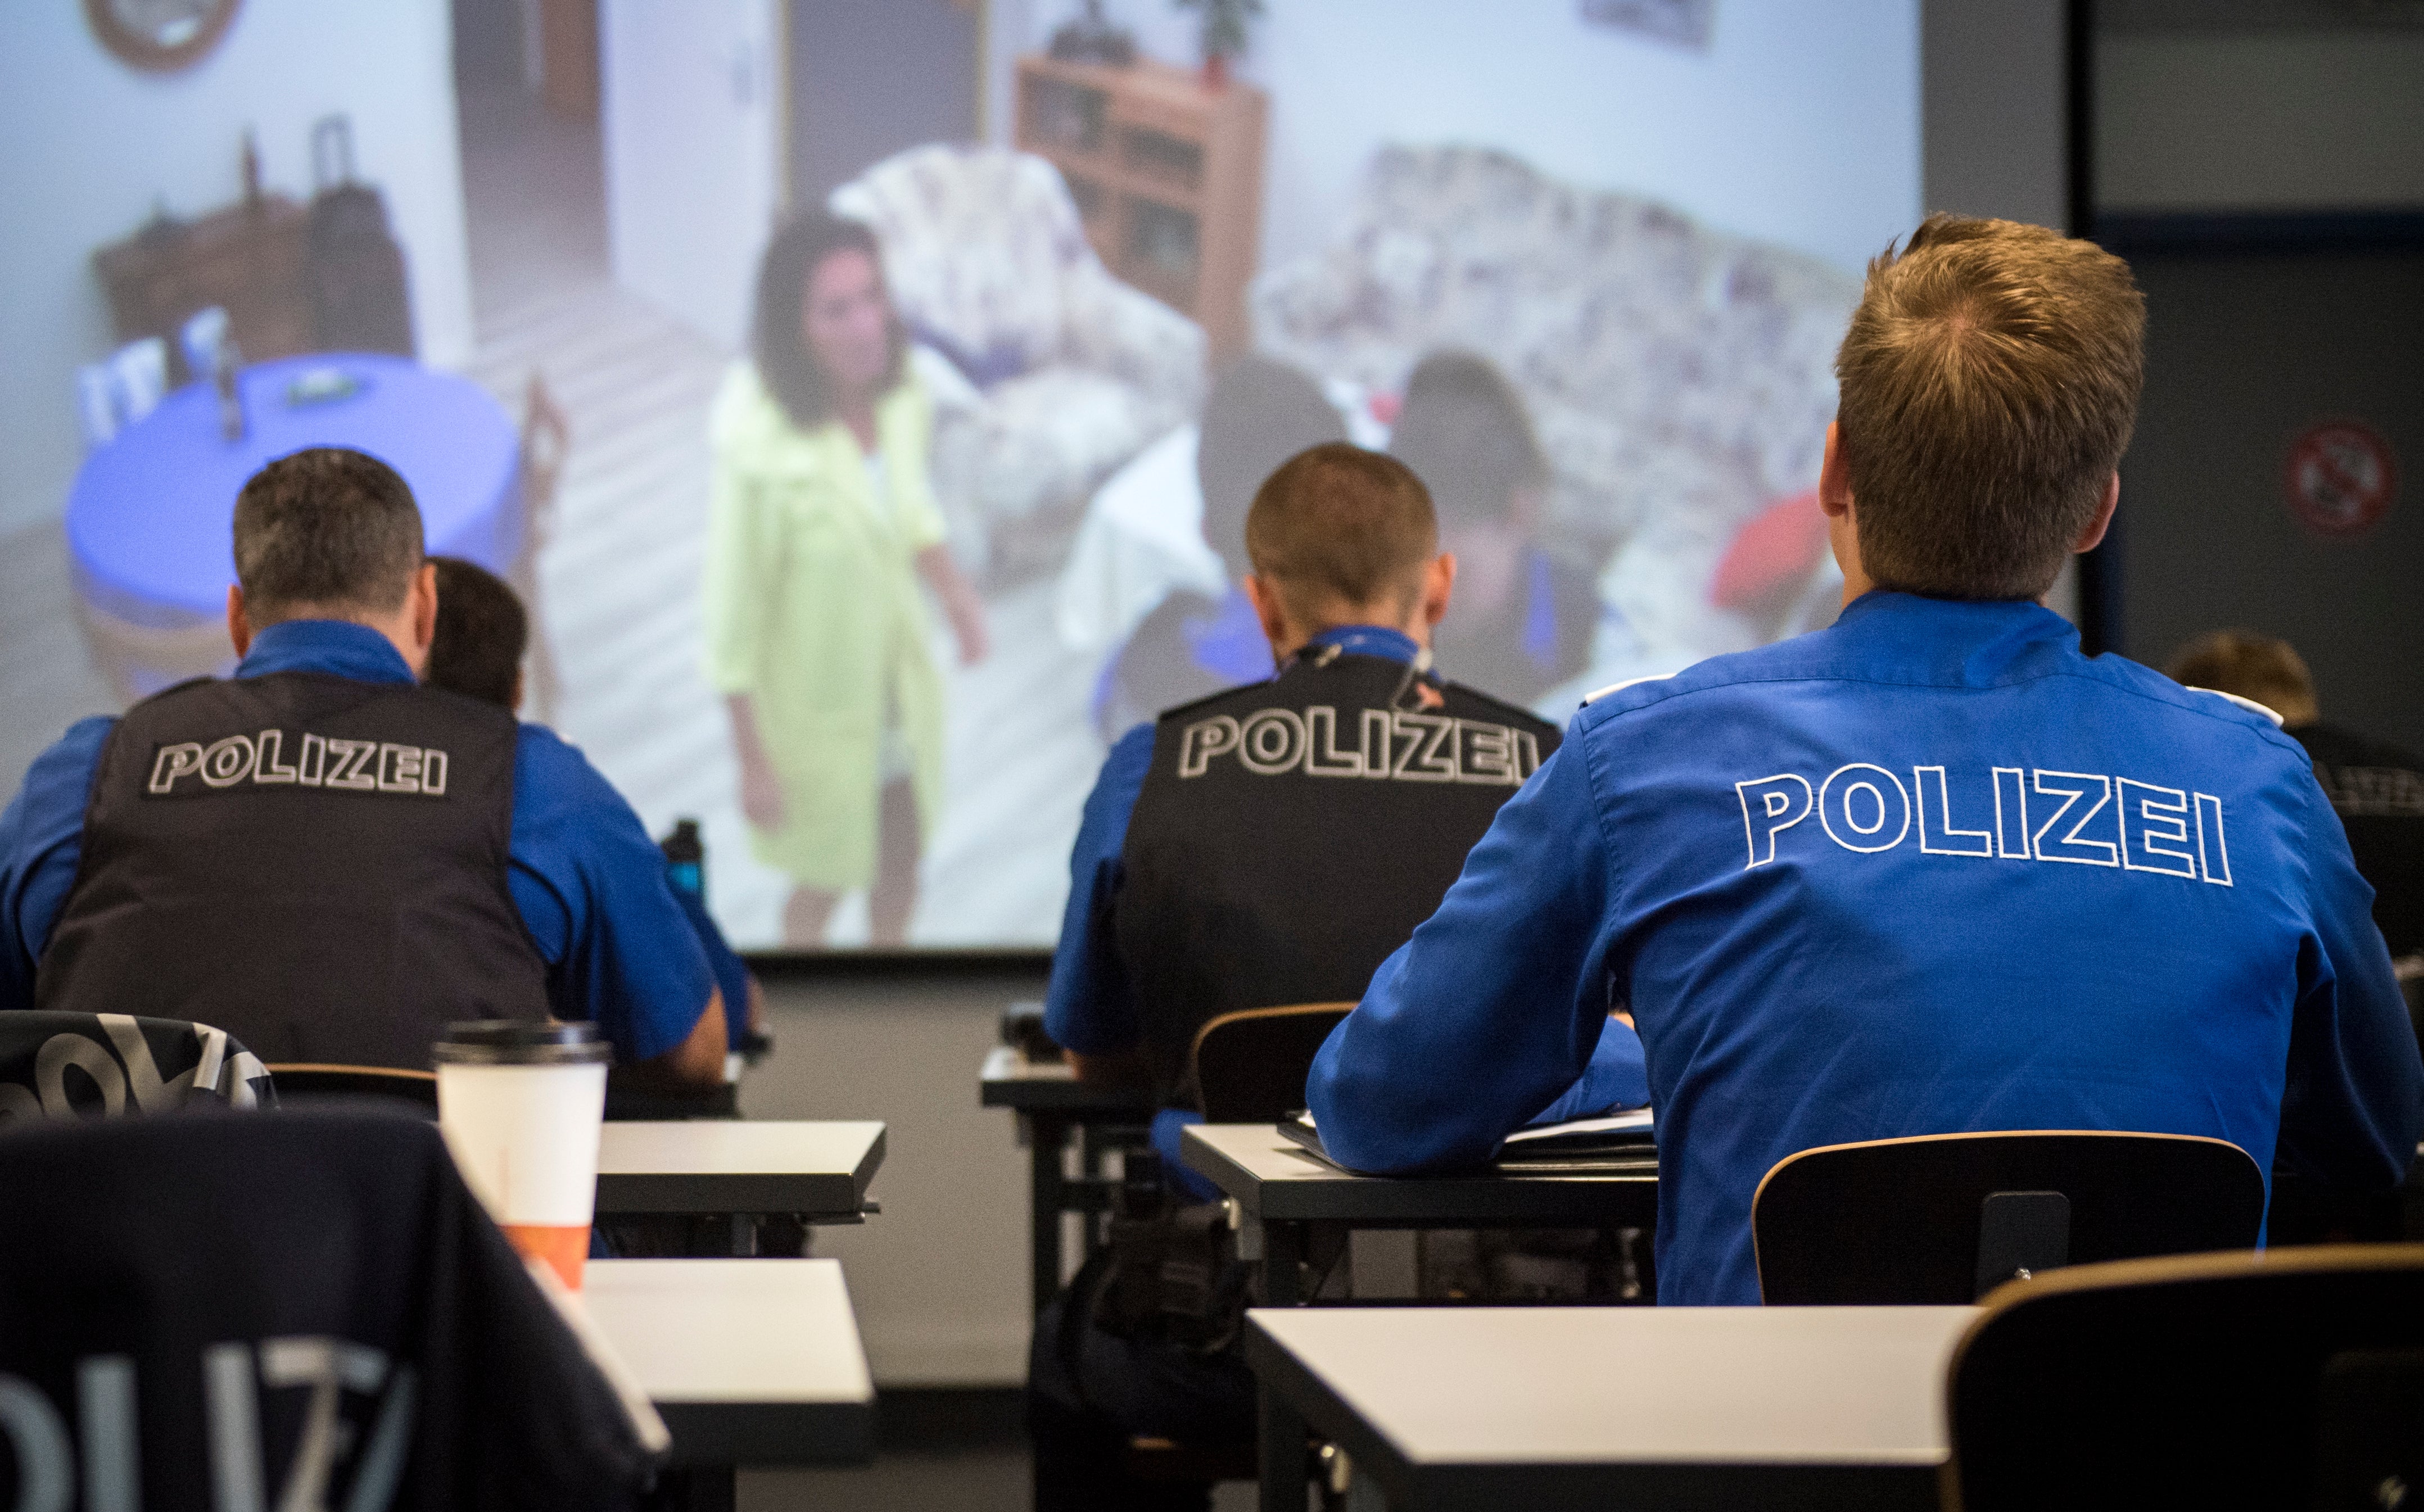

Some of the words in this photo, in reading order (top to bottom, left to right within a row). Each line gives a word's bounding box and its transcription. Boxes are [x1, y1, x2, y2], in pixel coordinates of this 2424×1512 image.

[148, 729, 449, 795] POLIZEI
[1178, 707, 1540, 786] POLIZEI
[1735, 763, 2233, 886] POLIZEI
